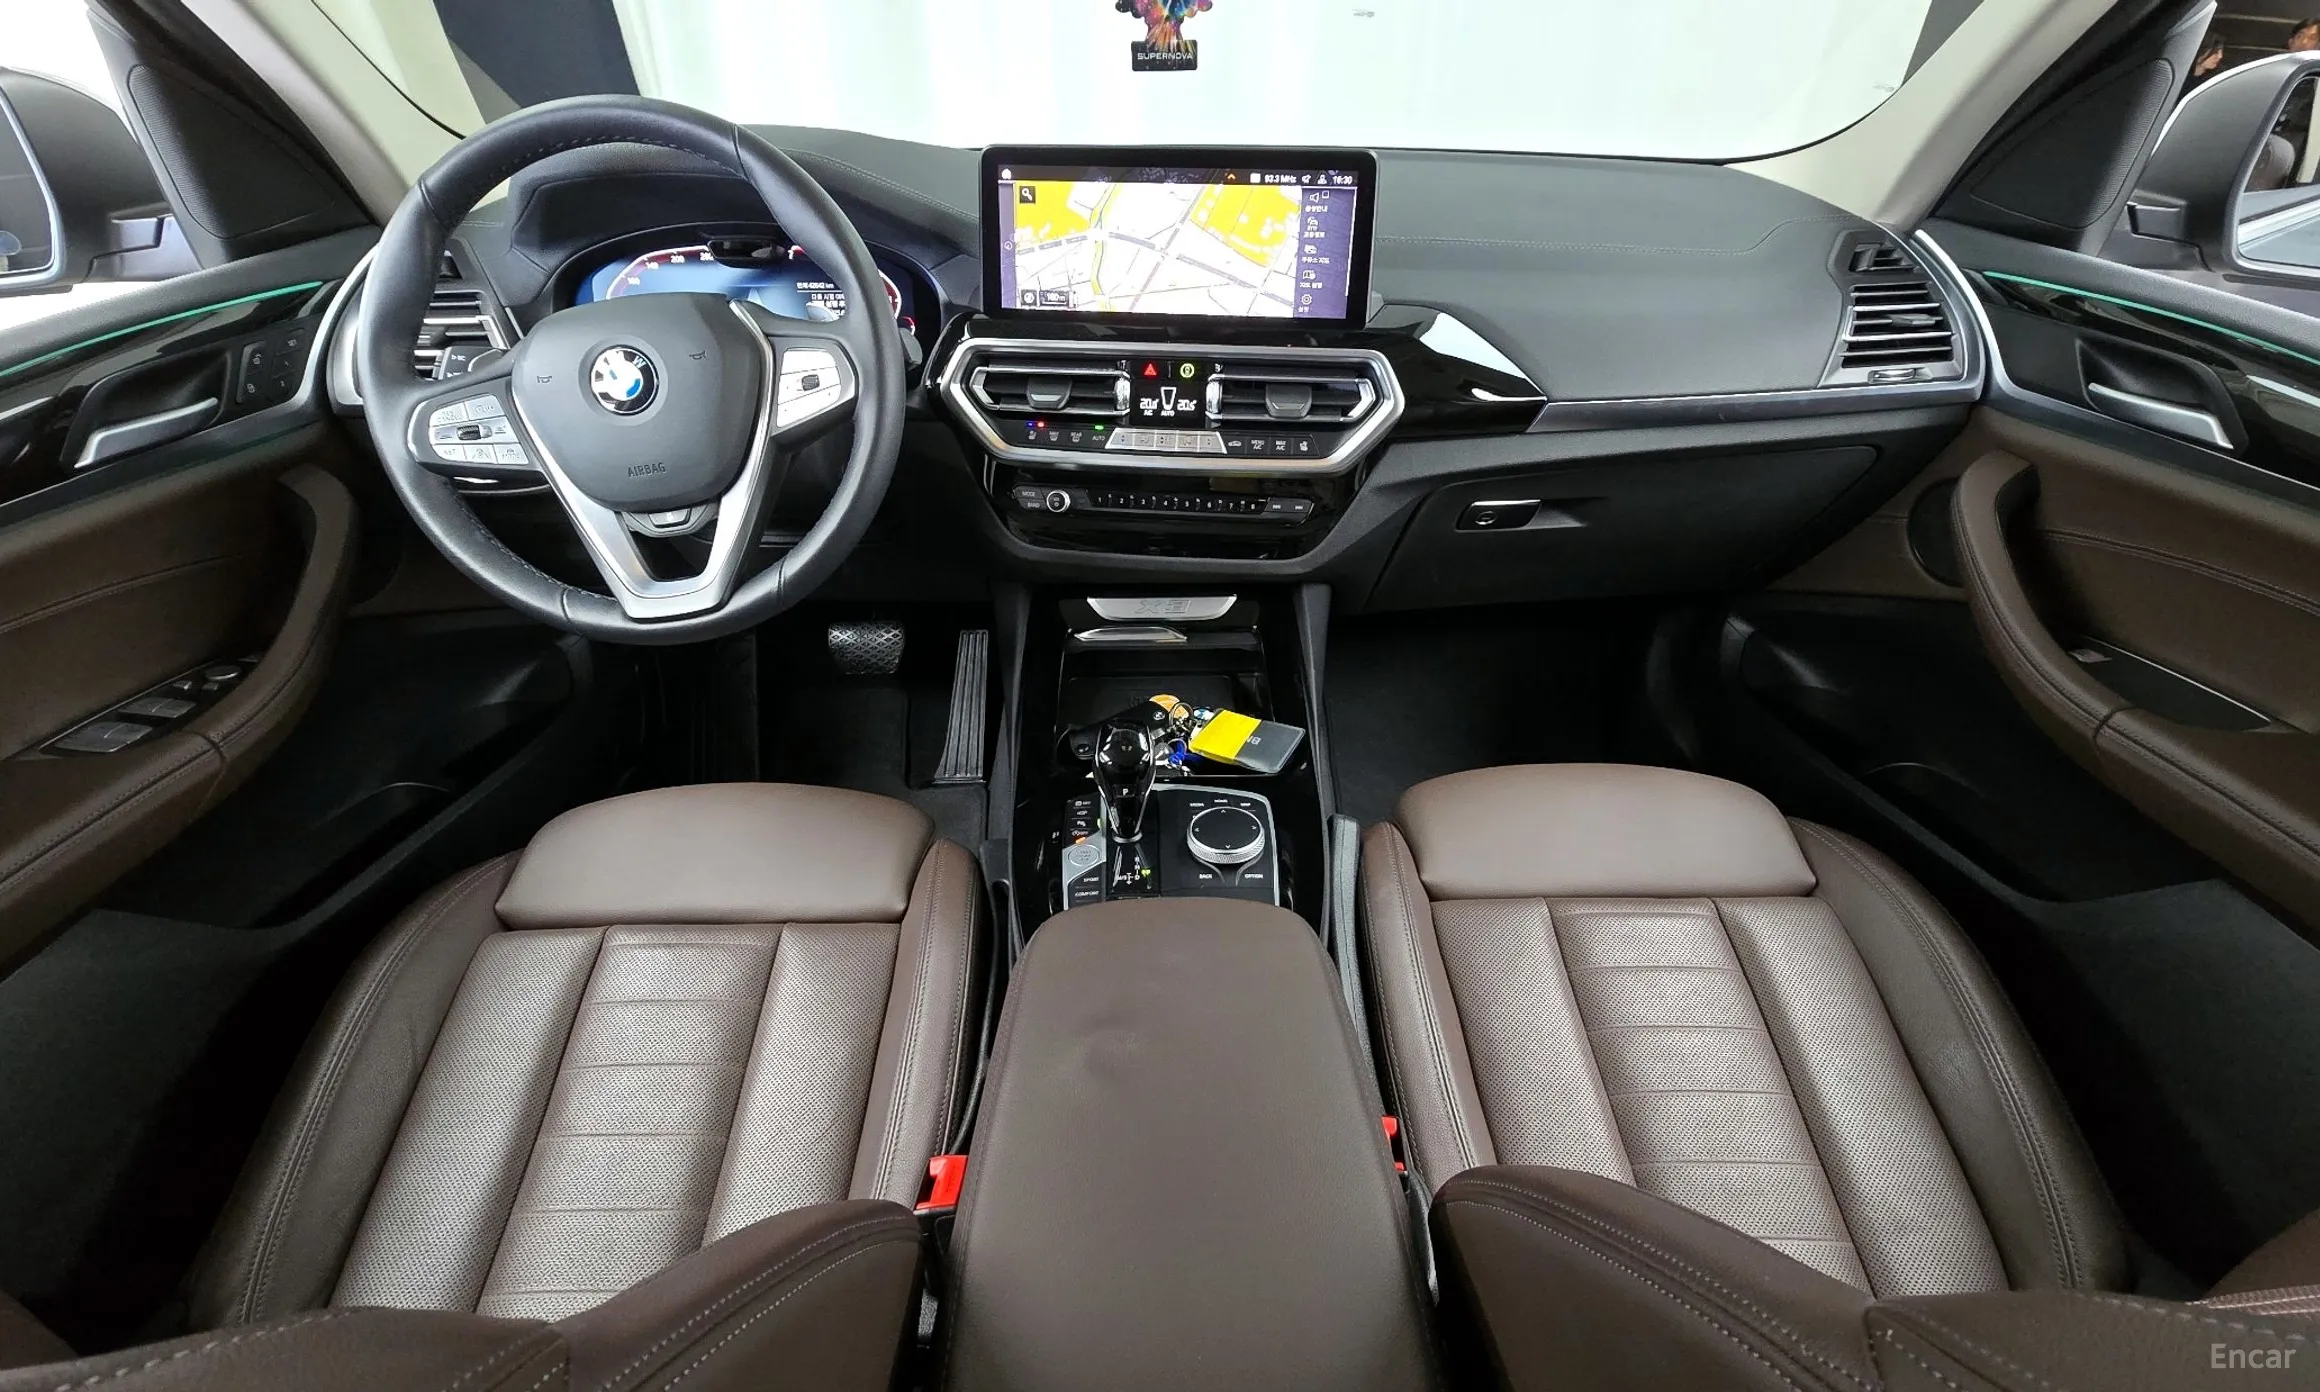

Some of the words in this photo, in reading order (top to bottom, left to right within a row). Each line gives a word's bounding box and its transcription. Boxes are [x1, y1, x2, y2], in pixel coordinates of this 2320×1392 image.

[1137, 52, 1194, 60] SUPERNOVA
[1264, 174, 1280, 183] 93.3
[1280, 174, 1297, 183] MHz
[628, 462, 666, 477] AIRBAG
[1122, 788, 1129, 796] P
